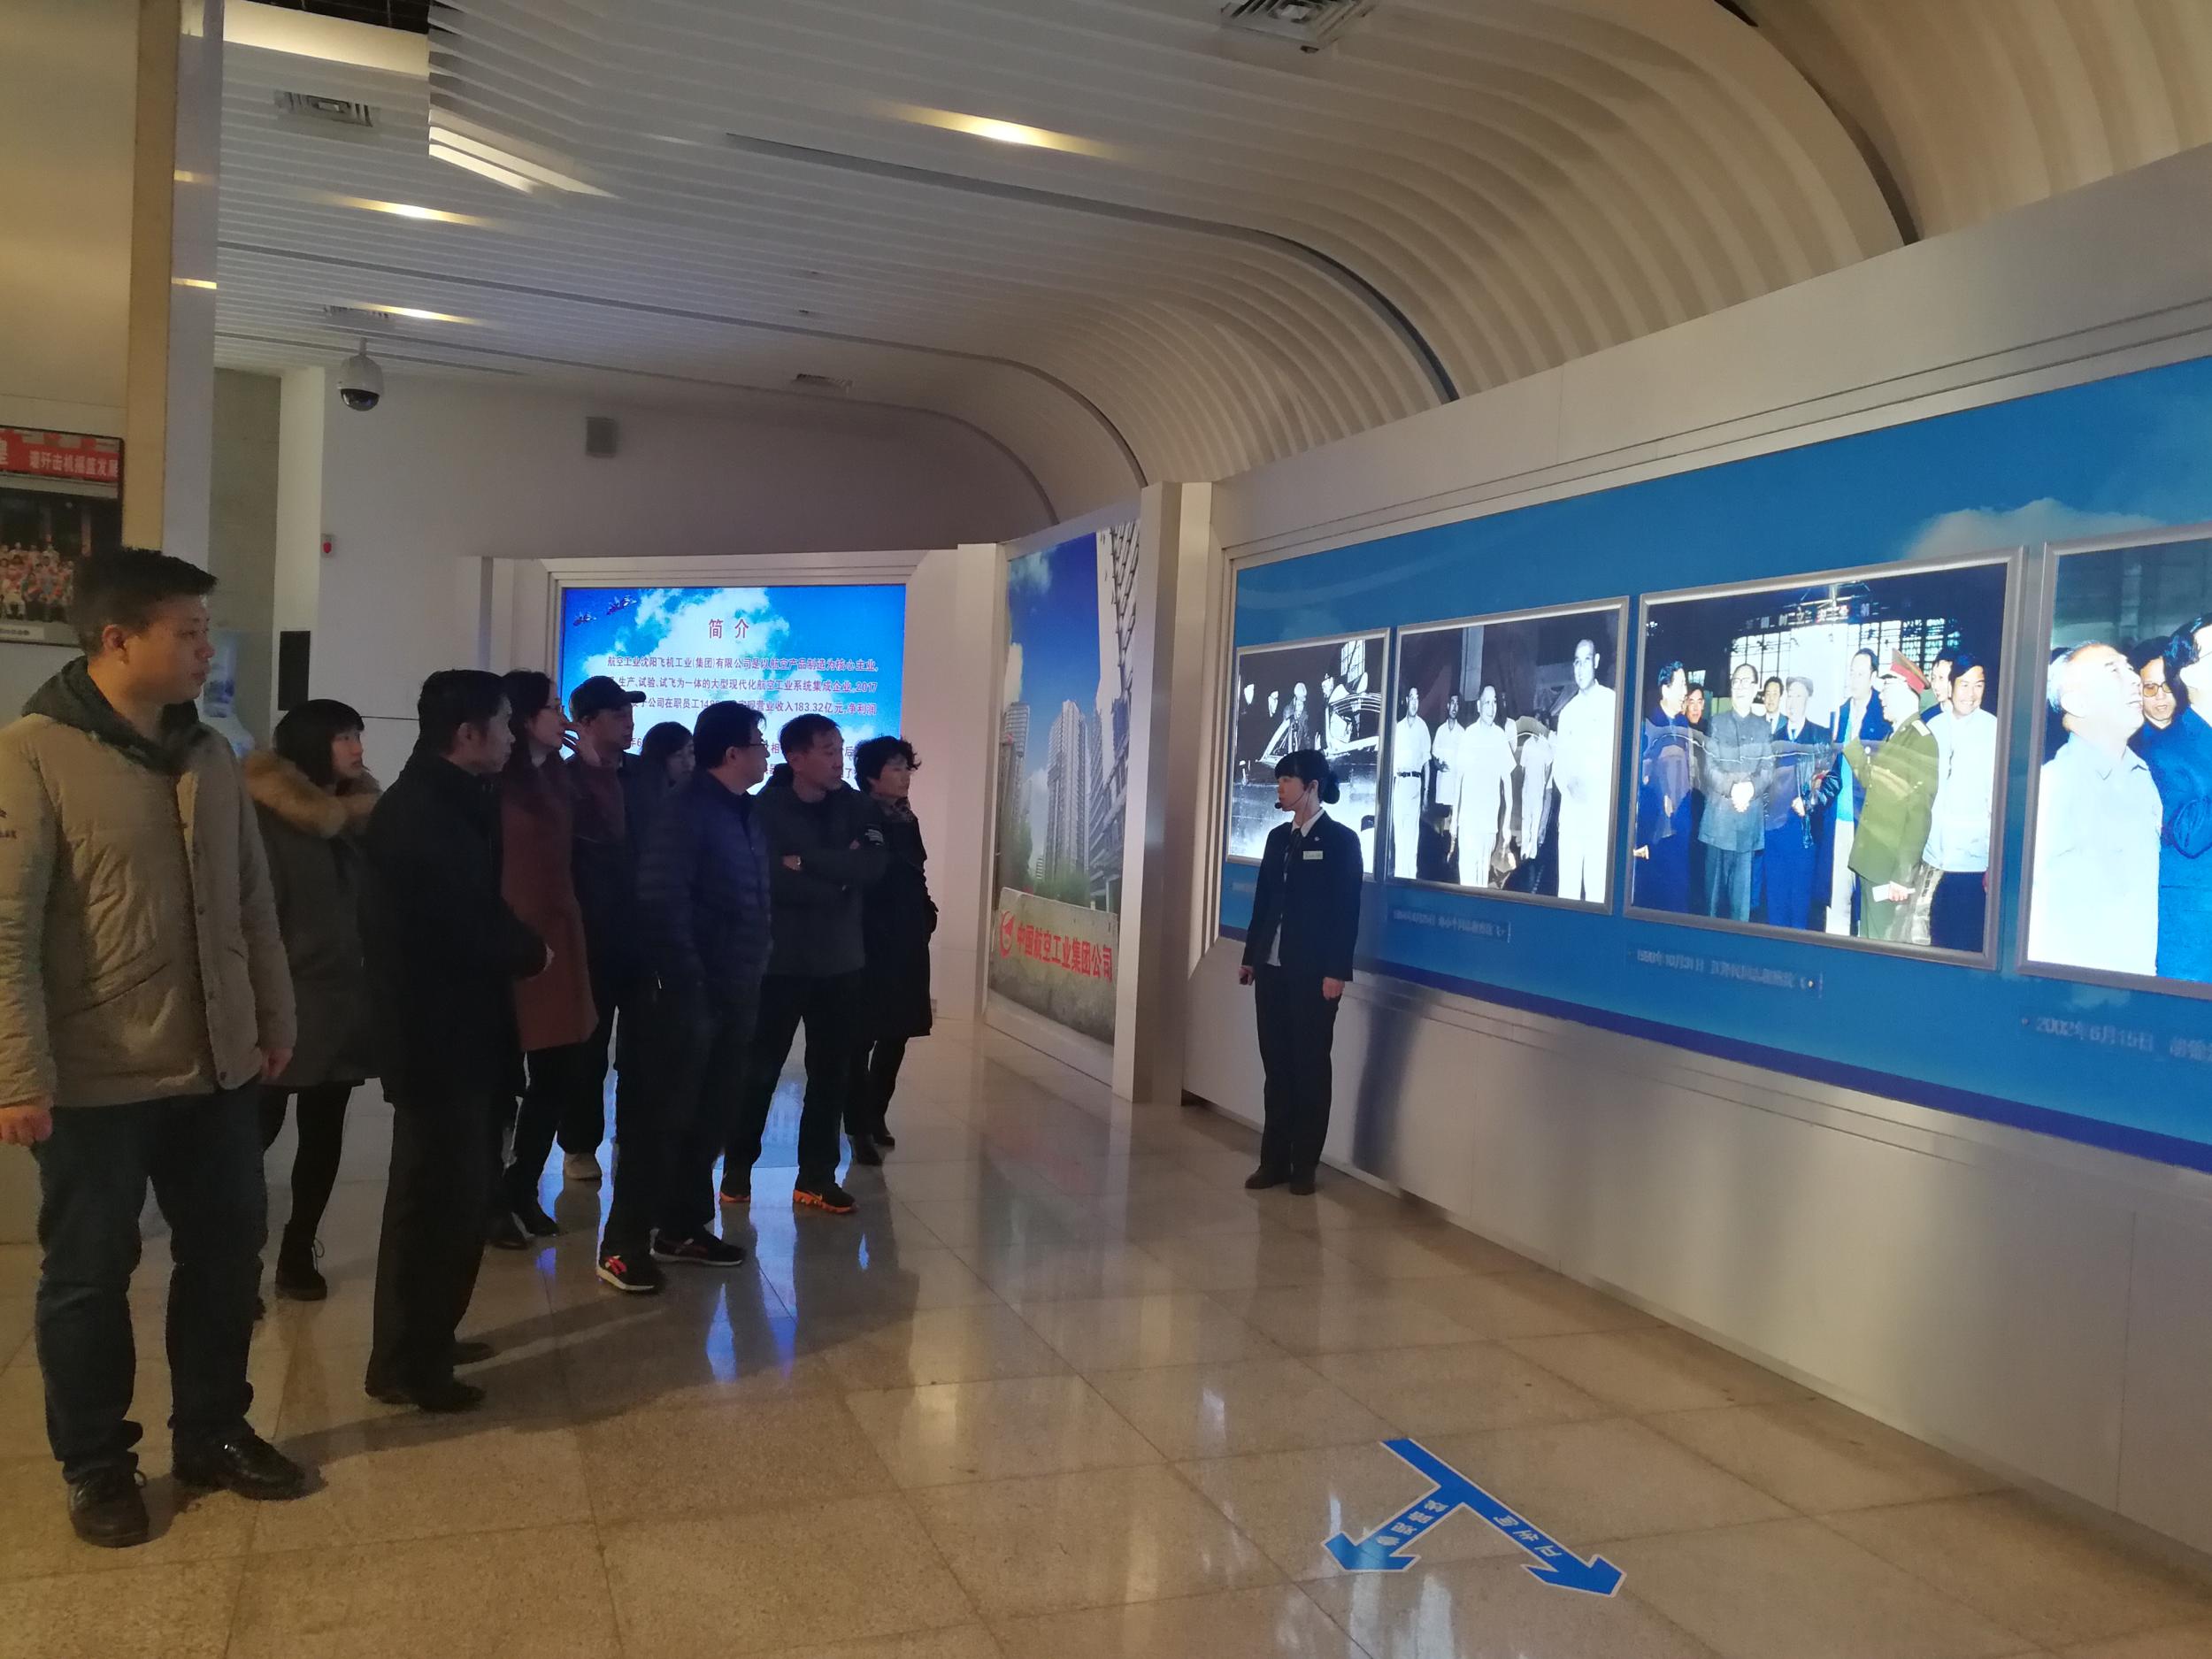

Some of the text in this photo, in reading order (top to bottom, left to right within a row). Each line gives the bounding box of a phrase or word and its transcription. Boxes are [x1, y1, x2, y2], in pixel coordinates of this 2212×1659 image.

[708, 618, 749, 638] 简介
[1017, 921, 1112, 983] 中国航空工业集团公司
[1494, 1515, 1563, 1557] 卫生间
